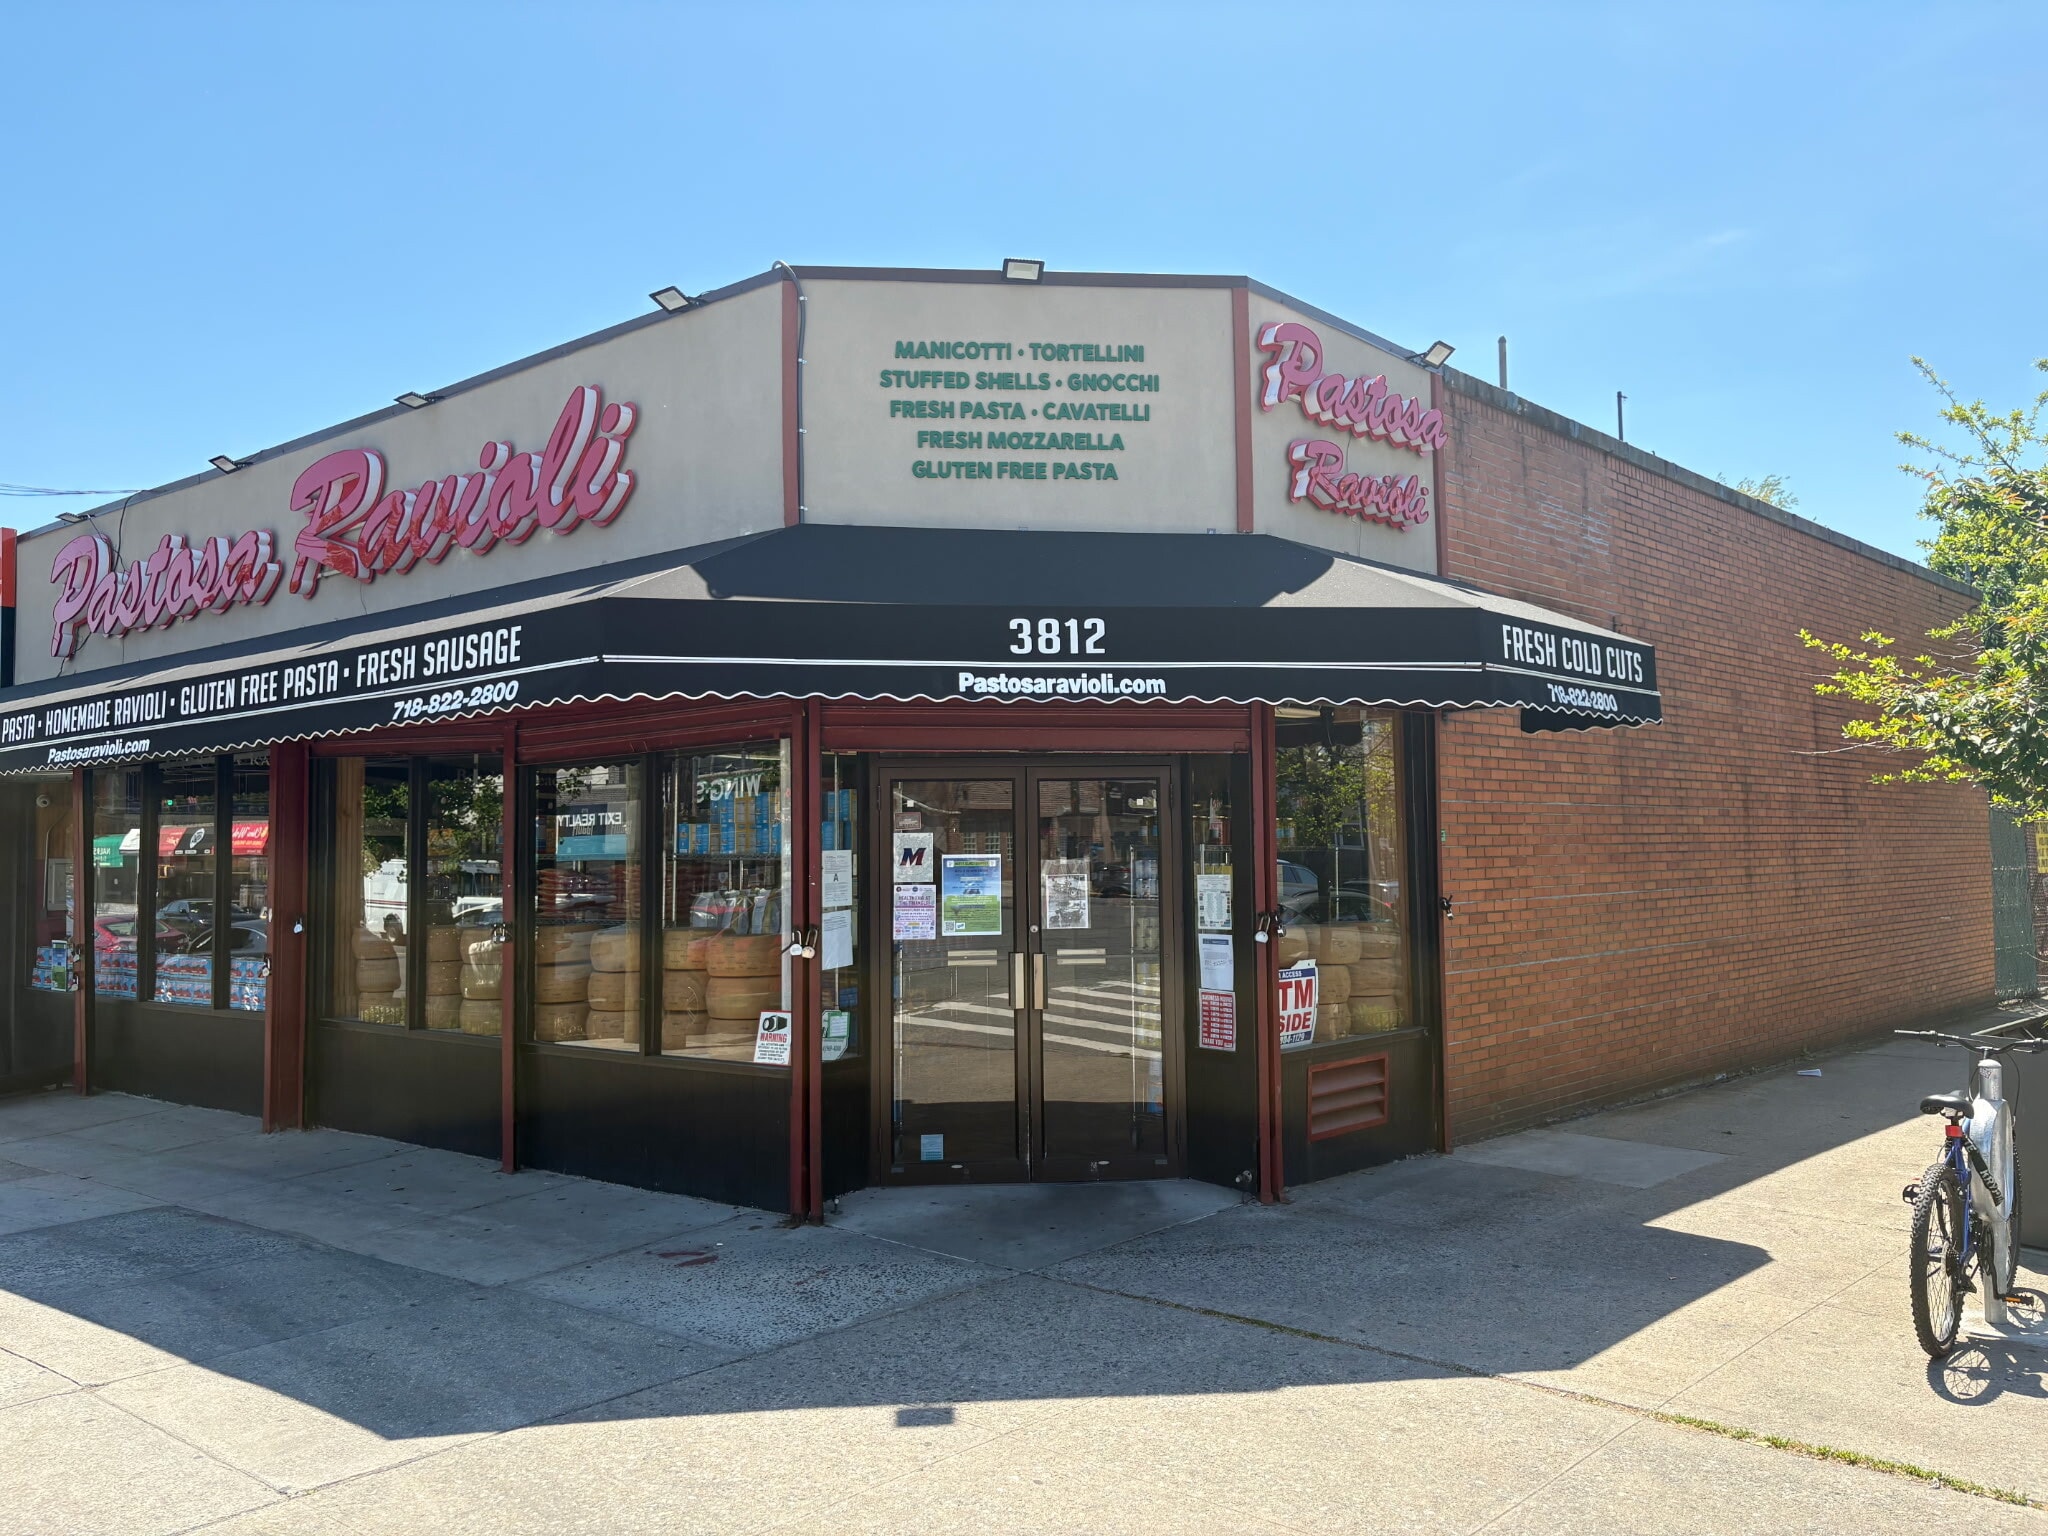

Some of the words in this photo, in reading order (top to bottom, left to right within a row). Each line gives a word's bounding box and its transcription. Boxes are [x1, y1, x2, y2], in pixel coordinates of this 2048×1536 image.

[894, 340, 1012, 361] MANICOTTI
[1028, 342, 1145, 363] TORTELLINI
[879, 369, 971, 389] STUFFED
[974, 371, 1051, 391] SHELLS
[1067, 373, 1160, 392] GNOCCHI
[1257, 322, 1449, 457] Pastosa
[889, 400, 955, 419] FRESH
[959, 401, 1026, 420] PASTA
[1042, 402, 1151, 422] CAVATELLI
[917, 430, 982, 449] FRESH
[987, 431, 1125, 451] MOZZARELLA
[911, 460, 993, 479] GLUTEN
[997, 461, 1047, 480] FREE
[1052, 462, 1119, 480] PASTA
[1287, 439, 1430, 533] Ravioli
[50, 527, 283, 660] Pastosa
[288, 384, 639, 599] Ravioli
[1008, 617, 1106, 655] 3812
[1502, 624, 1557, 668] FRESH
[1561, 637, 1602, 675] COLD
[1605, 646, 1643, 683] CUTS
[1, 713, 36, 743] PASTA
[45, 699, 111, 737] HOMEMADE
[114, 690, 167, 726] RAVIOLI
[180, 678, 236, 715] GLUTEN
[240, 670, 279, 706] FREE
[283, 659, 338, 700] PASTA
[356, 646, 416, 688] FRESH
[423, 625, 522, 676] SAUSAGE
[958, 672, 1166, 694] Pastosaravioli.com
[393, 679, 519, 721] 718-822-2800
[1547, 683, 1618, 712] 718-822-2800
[47, 737, 151, 764] Pastosaravioli.com
[1279, 978, 1313, 1011] TM
[1280, 1011, 1312, 1034] SIDE
[760, 1033, 788, 1043] WARNING
